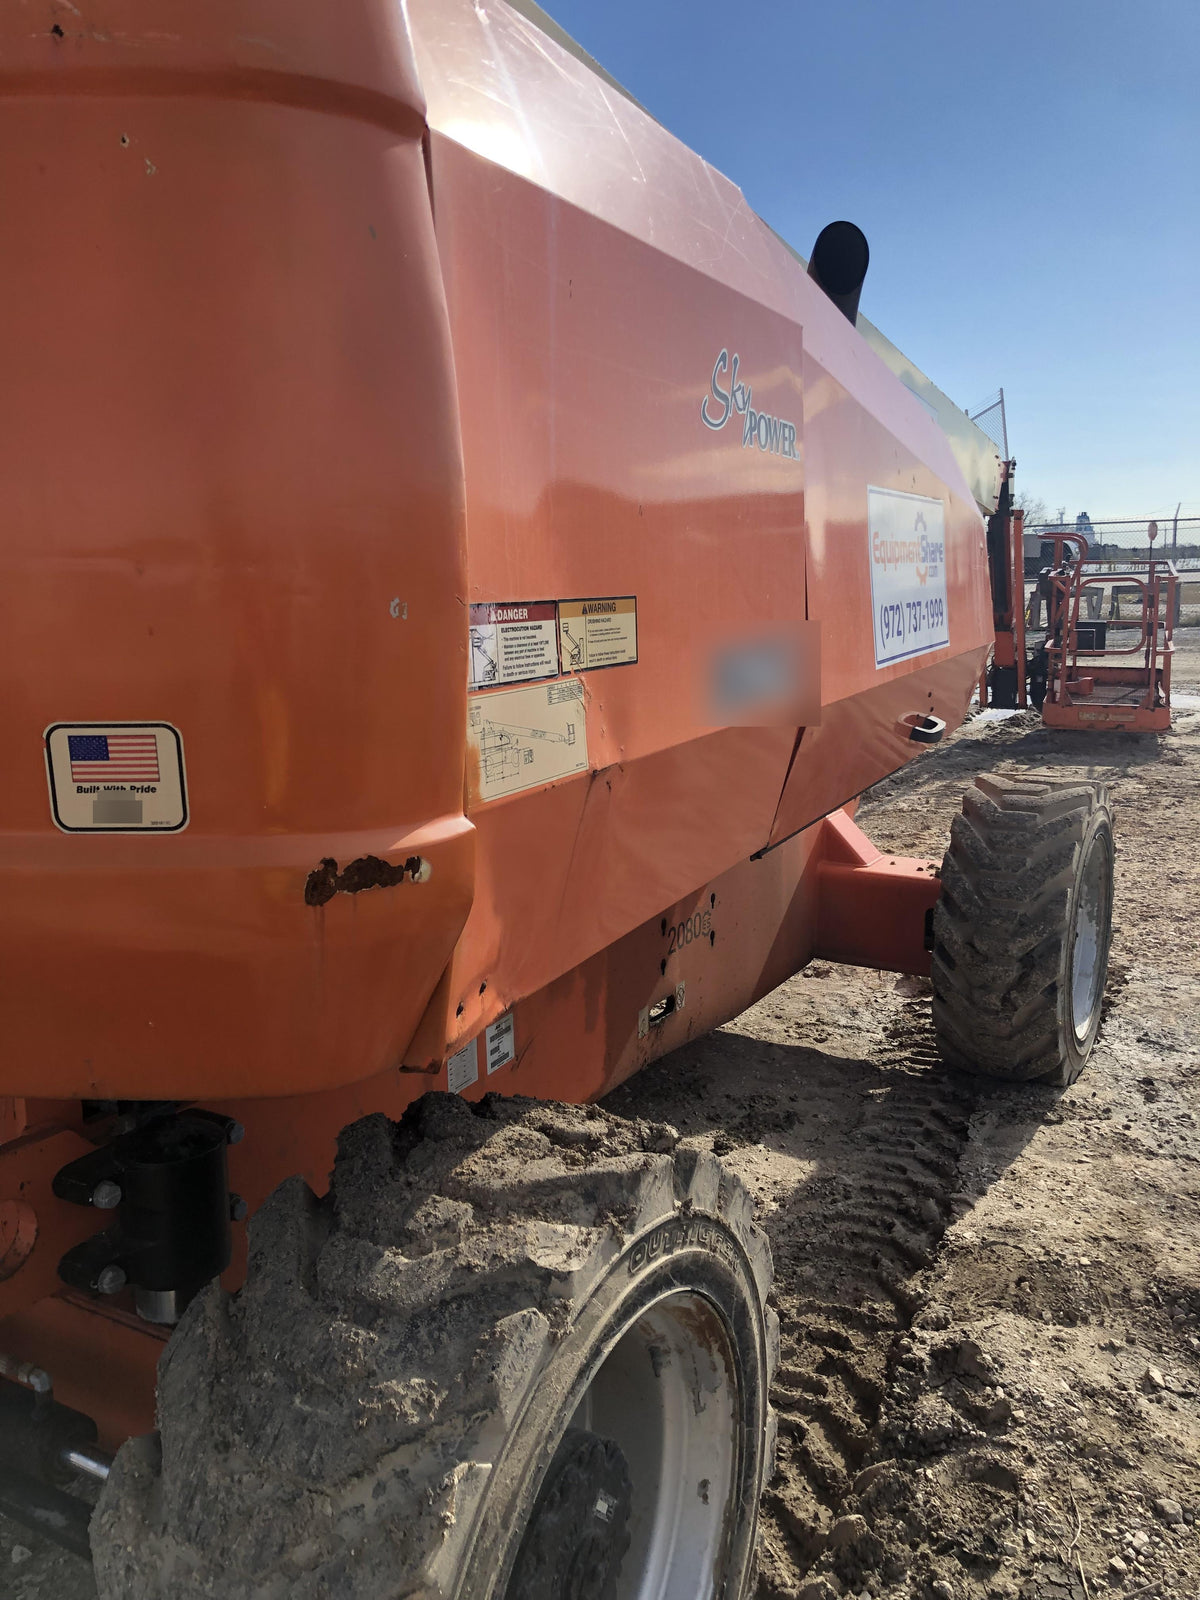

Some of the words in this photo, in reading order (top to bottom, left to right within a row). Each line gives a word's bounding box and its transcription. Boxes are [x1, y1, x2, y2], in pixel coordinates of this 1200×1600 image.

[701, 348, 752, 448] Sky
[747, 408, 800, 461] POWER
[873, 532, 944, 572] EquipmentShare
[497, 609, 528, 621] DANGER
[588, 602, 616, 613] WARNING
[880, 602, 905, 649] (972)
[906, 598, 944, 634] 737-1999
[76, 785, 100, 794] Built
[129, 785, 157, 794] Pride
